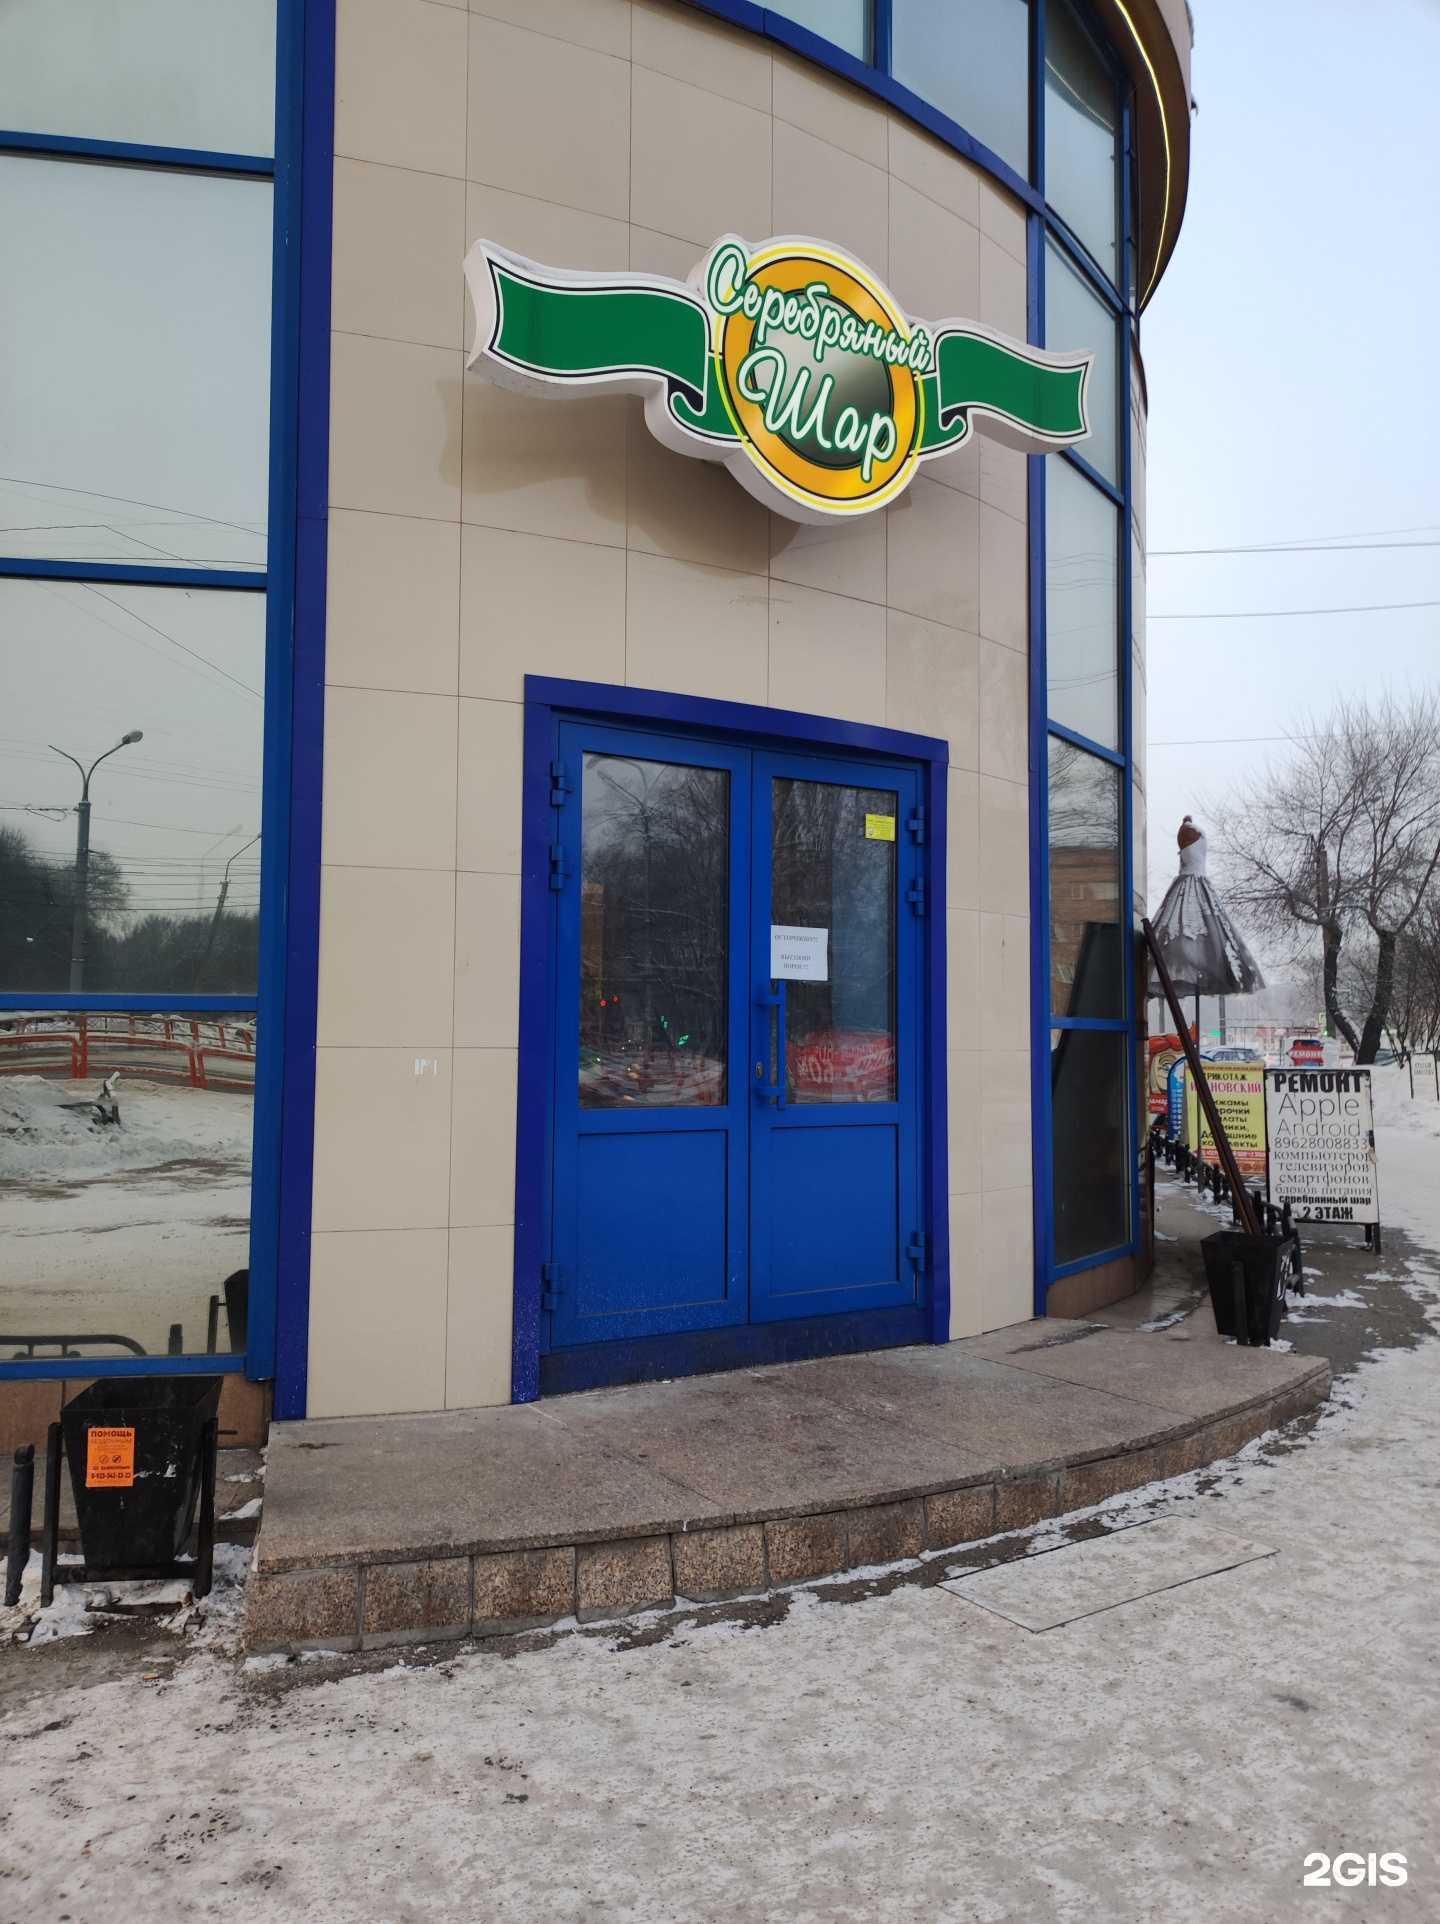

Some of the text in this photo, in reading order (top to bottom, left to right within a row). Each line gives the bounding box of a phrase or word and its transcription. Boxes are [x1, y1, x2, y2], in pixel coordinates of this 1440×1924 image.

[707, 243, 932, 371] Серебряный
[737, 346, 897, 482] Шар
[1274, 1072, 1361, 1093] РЕМОНТ
[1278, 1093, 1360, 1122] Apple
[1277, 1118, 1360, 1137] Android
[1274, 1137, 1368, 1150] 89628008833
[1279, 1162, 1369, 1176] телевизоров
[1279, 1172, 1370, 1186] смартфонов
[1350, 1196, 1372, 1206] шар
[1302, 1206, 1354, 1220] 2 ЭТАЖ
